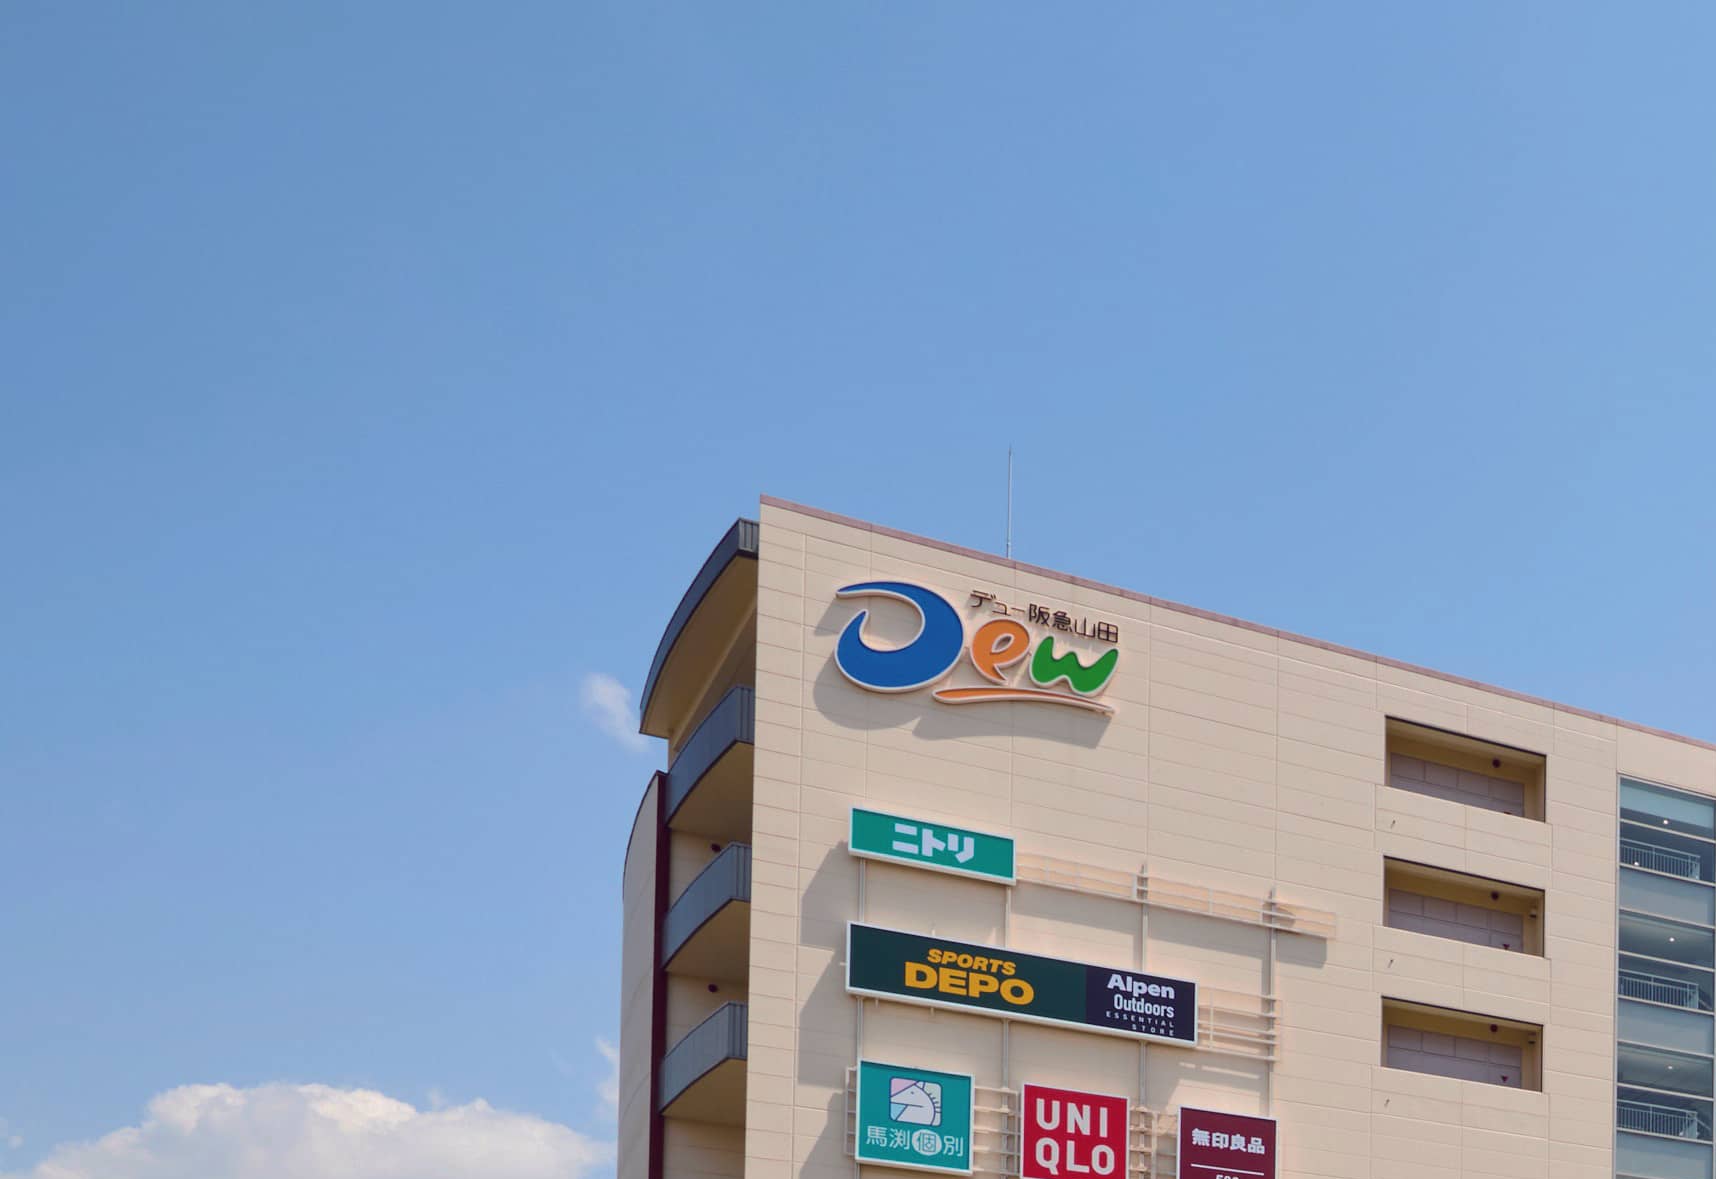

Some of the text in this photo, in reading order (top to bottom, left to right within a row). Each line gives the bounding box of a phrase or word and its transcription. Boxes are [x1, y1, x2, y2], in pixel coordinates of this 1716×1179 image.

[969, 589, 1119, 644] デュー阪急山田
[892, 822, 975, 864] ニトリ
[927, 948, 1016, 976] SPORTS
[904, 960, 1034, 1006] DEPO
[1107, 973, 1175, 999] Alpen
[1105, 1011, 1175, 1028] ESSENTIAL
[1113, 993, 1175, 1019] Outdoors
[1131, 1023, 1175, 1036] STORE
[1035, 1097, 1109, 1138] UNI
[1191, 1128, 1266, 1155] 無印良品
[1035, 1137, 1116, 1176] QLO
